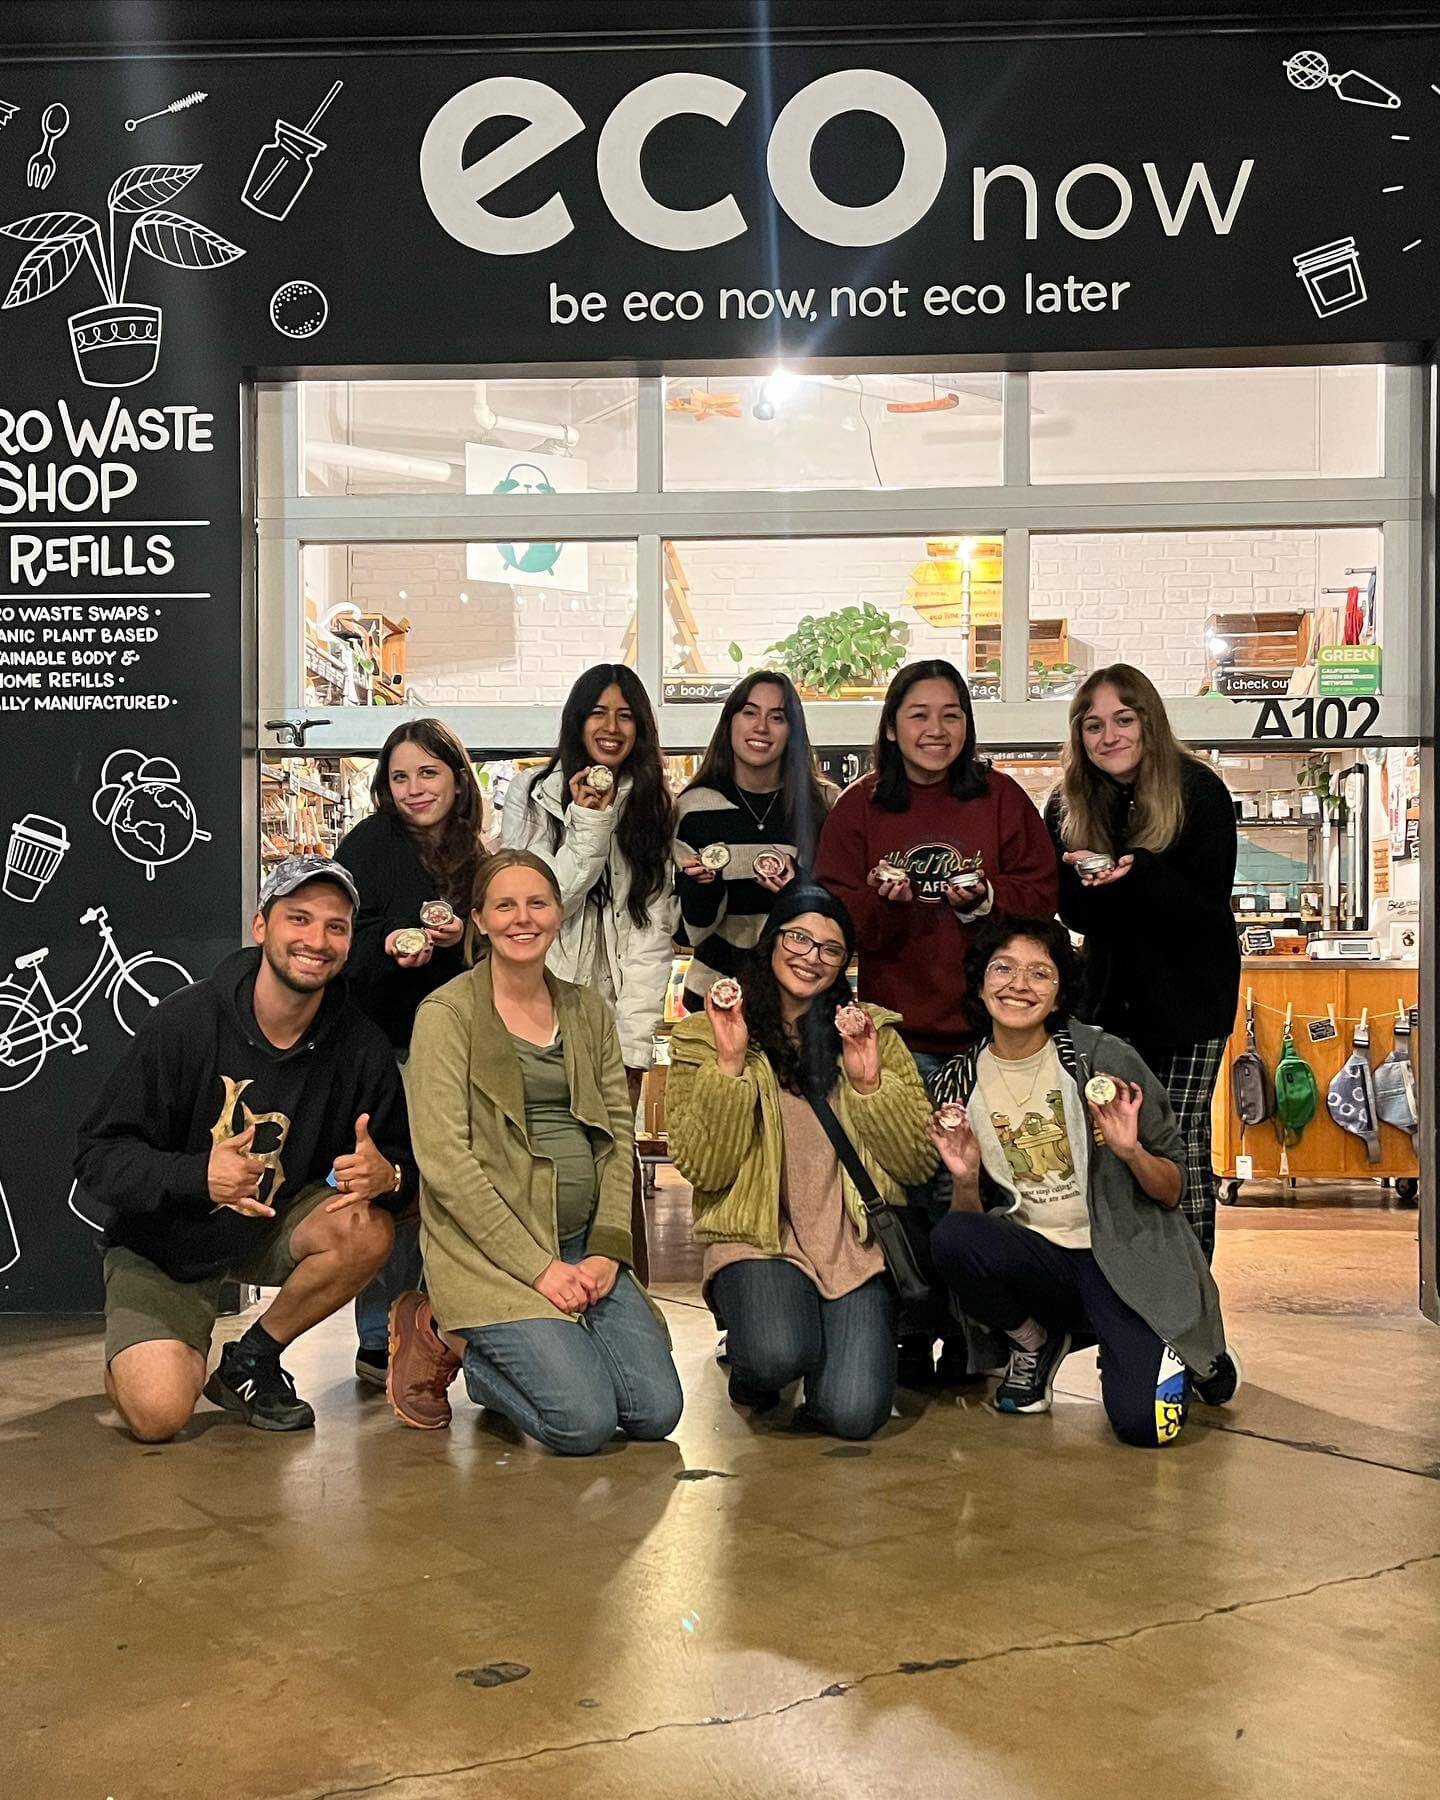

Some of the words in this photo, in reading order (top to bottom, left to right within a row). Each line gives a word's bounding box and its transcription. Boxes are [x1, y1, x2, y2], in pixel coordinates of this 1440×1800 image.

[420, 69, 946, 255] eco
[973, 159, 1254, 241] now
[549, 282, 607, 324] be
[623, 290, 704, 322] eco
[719, 288, 818, 322] now,
[830, 279, 909, 318] not
[923, 284, 1006, 316] eco
[1025, 272, 1131, 315] later
[58, 396, 214, 459] WASTE
[0, 460, 138, 515] SHOP
[10, 534, 175, 587] REFILLS
[0, 607, 15, 622] O
[19, 605, 83, 622] WASTE
[88, 605, 150, 622] SWAPS
[42, 628, 97, 643] PLANT
[101, 626, 159, 644] BASED
[0, 650, 67, 666] AINABLE
[72, 650, 117, 666] BODY
[120, 649, 141, 666] &
[1321, 648, 1376, 662] GREEN
[49, 671, 115, 689] REFILLS
[1232, 679, 1269, 690] check
[680, 684, 714, 697] body
[0, 695, 31, 711] LLY
[34, 694, 170, 711] MANUFACTURED
[1252, 696, 1384, 740] A102
[917, 880, 947, 893] AFE
